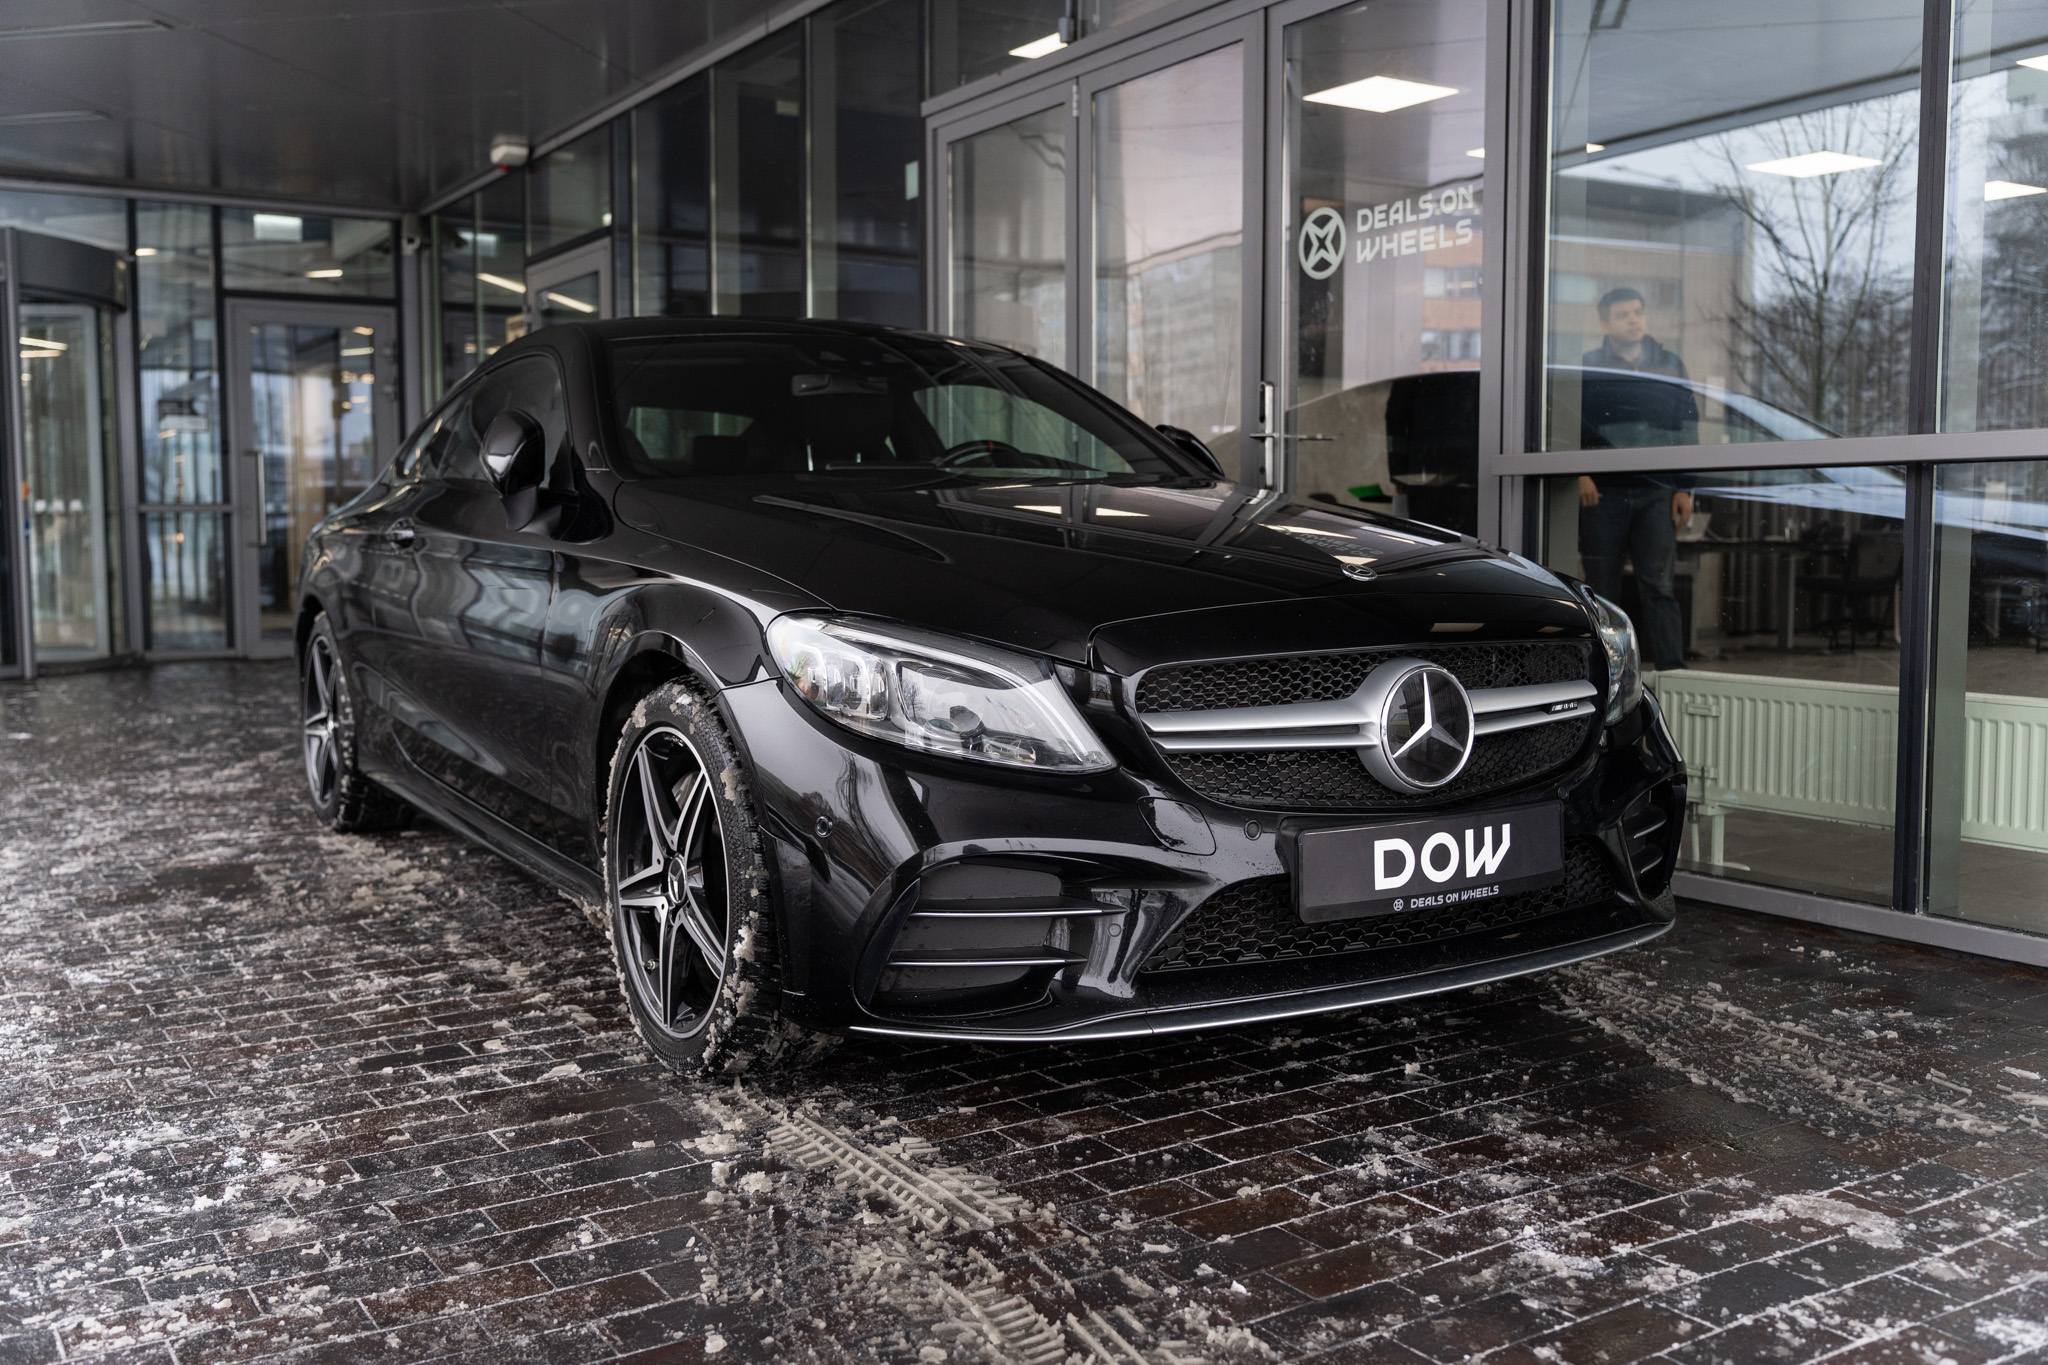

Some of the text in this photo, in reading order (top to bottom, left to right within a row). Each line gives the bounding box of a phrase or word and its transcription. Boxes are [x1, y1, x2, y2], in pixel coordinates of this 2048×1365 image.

[1357, 185, 1474, 233] DEALS ON
[1357, 218, 1473, 264] WHEELS
[1374, 823, 1510, 890] DOW
[1410, 885, 1500, 909] DEALS ON WHEELS
